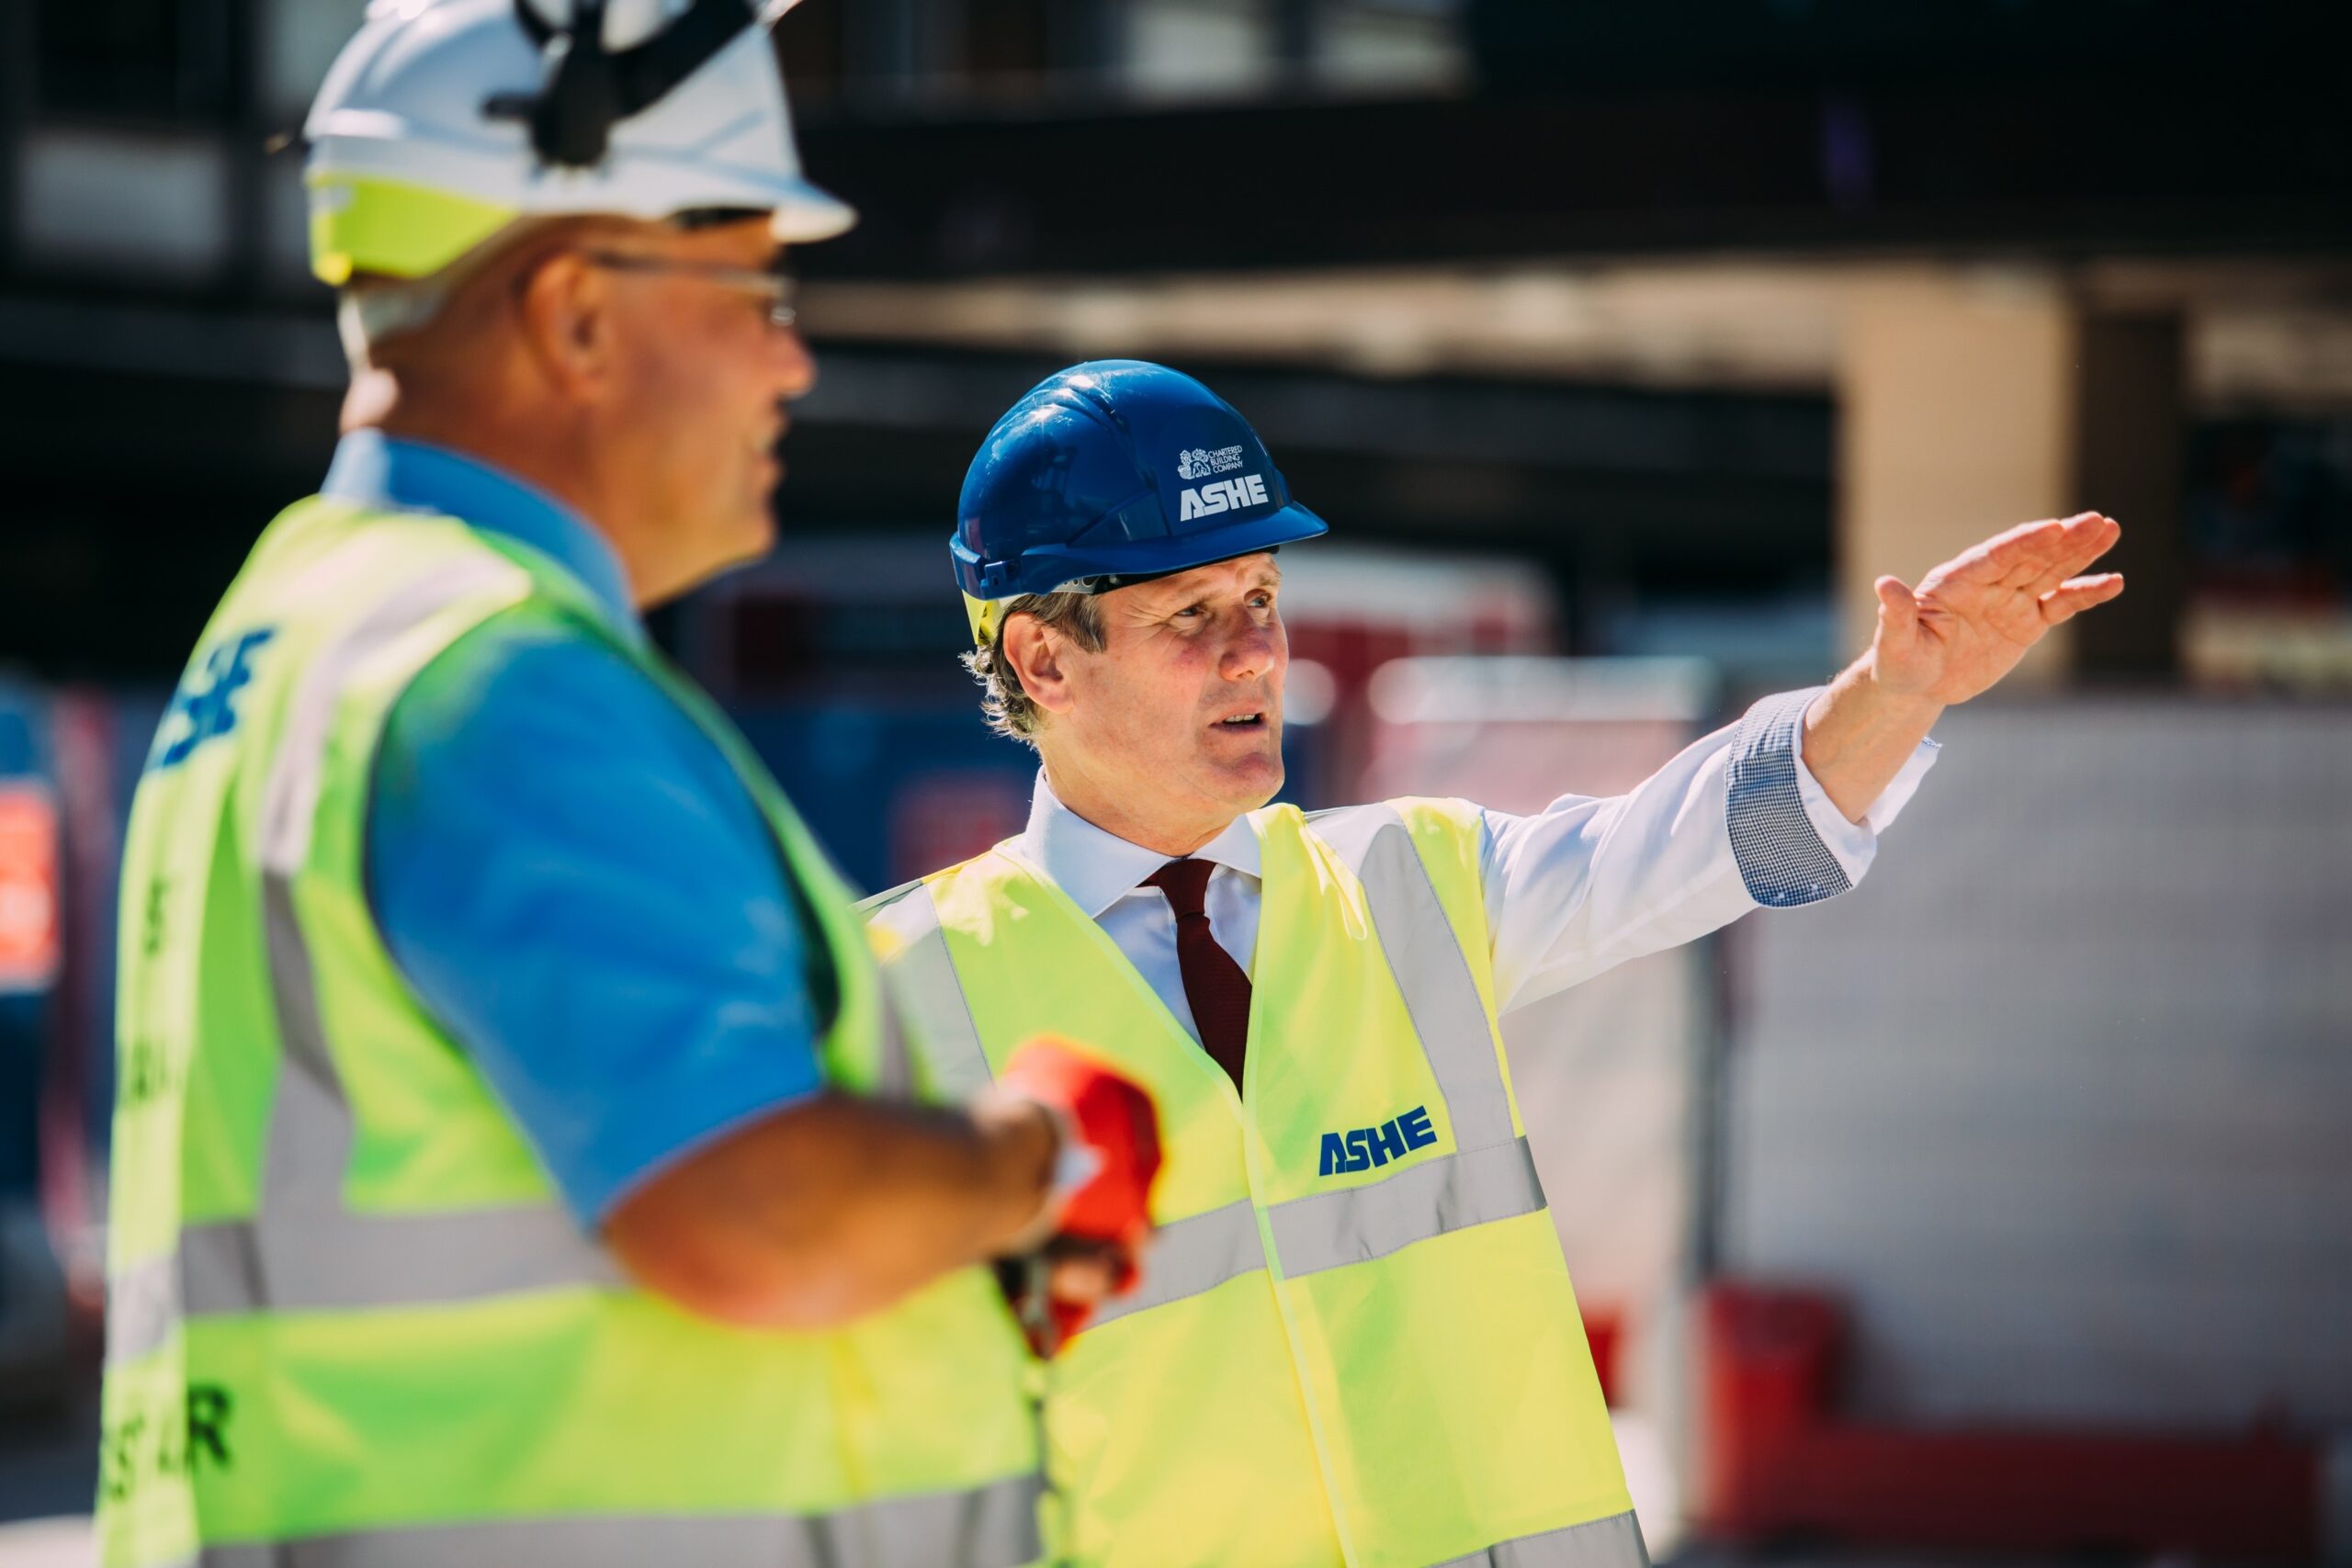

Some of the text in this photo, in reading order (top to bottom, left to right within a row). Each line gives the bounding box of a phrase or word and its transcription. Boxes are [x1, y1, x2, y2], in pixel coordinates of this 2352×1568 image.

[1207, 445, 1243, 459] CHARTERED
[1210, 453, 1240, 466] BUILDING
[1213, 459, 1243, 473] COMPANY
[1180, 474, 1269, 522] ASHE
[1319, 1105, 1438, 1177] ASHE
